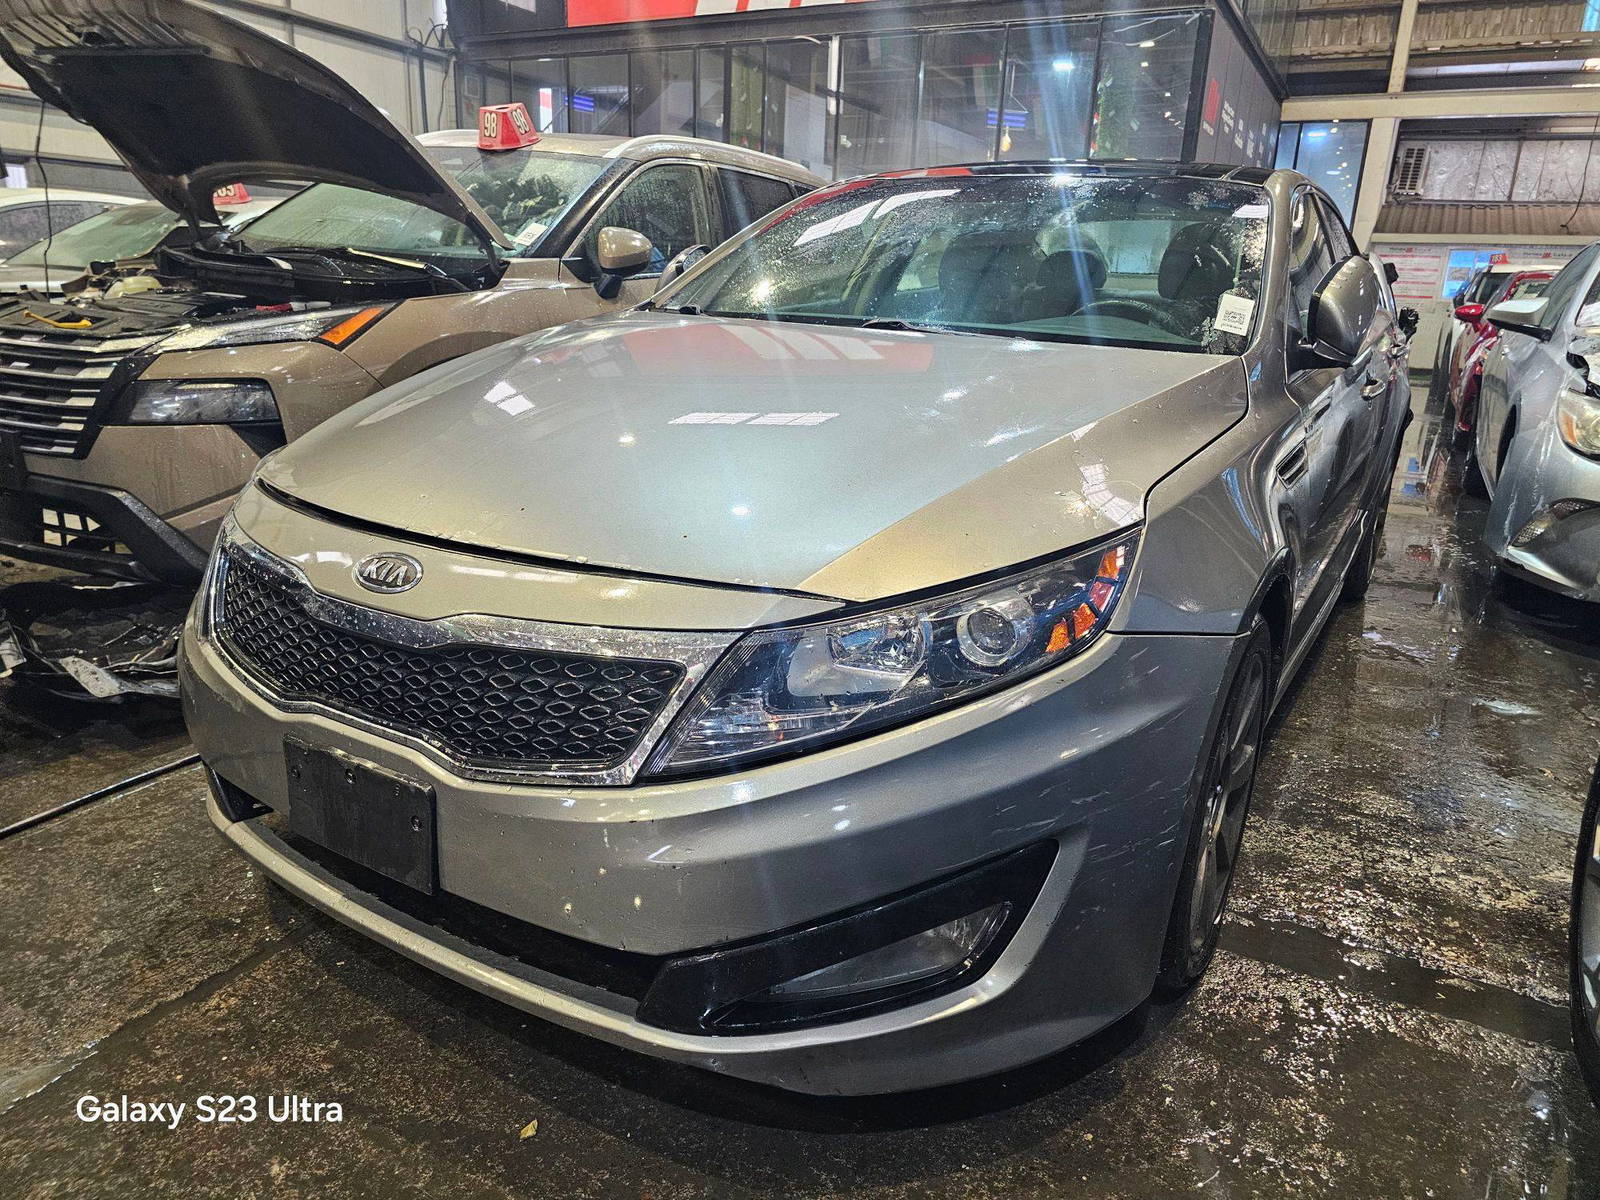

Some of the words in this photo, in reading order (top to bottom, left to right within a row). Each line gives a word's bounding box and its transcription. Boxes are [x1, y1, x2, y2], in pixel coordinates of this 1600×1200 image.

[483, 111, 498, 138] 98
[511, 108, 530, 135] 98
[362, 558, 408, 587] KIA
